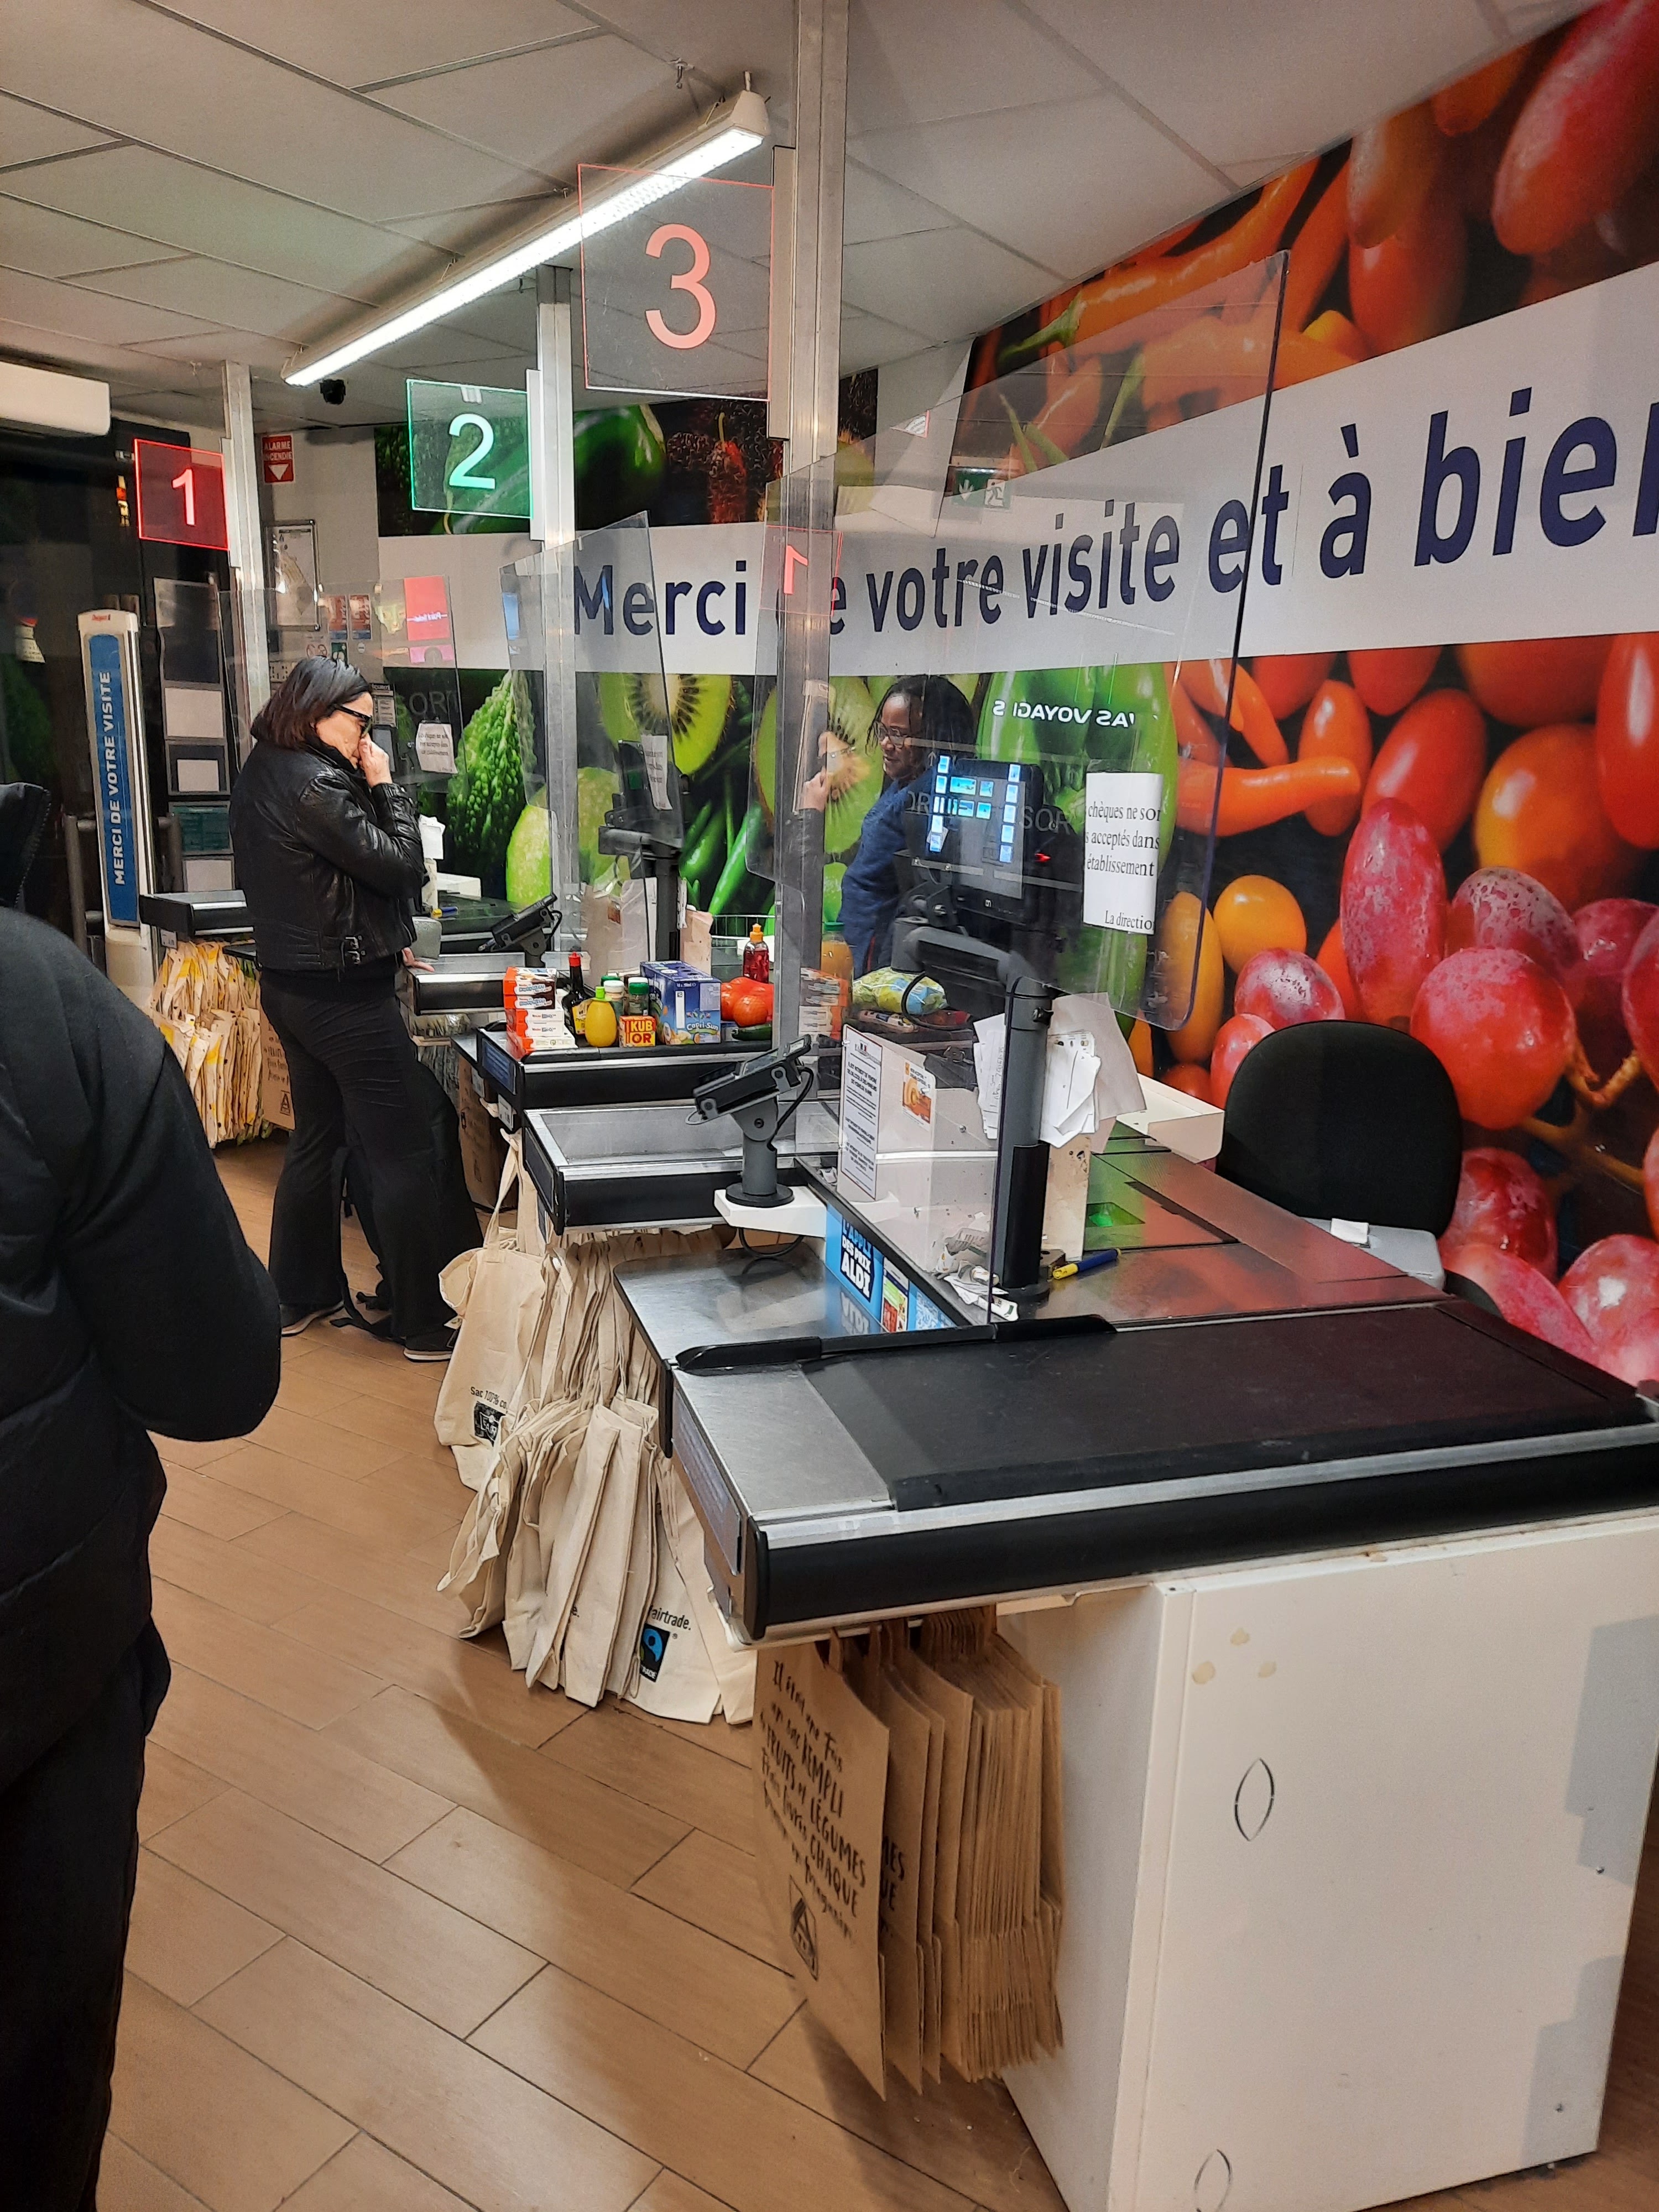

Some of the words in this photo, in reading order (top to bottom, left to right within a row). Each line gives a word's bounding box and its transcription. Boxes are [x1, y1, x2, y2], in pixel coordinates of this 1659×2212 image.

[645, 223, 717, 349] 3
[264, 440, 291, 451] ALARME
[448, 413, 495, 489] 2
[171, 468, 196, 526] 1
[575, 560, 748, 635] Merci
[866, 547, 1005, 634] votre
[1022, 499, 1180, 619] visite
[1208, 464, 1290, 594] et
[1319, 423, 1372, 579] à
[99, 671, 115, 733] VISITE
[103, 734, 120, 797] VOTRE
[110, 799, 122, 825] DE
[1088, 801, 1124, 823] chèques
[1126, 807, 1137, 820] ne
[112, 828, 126, 885] MERCI
[1091, 830, 1130, 851] acceptés
[1132, 830, 1160, 850] dans
[1087, 853, 1155, 877] établissement
[1104, 910, 1114, 925] La
[1116, 912, 1155, 931] directio
[631, 1020, 653, 1032] KUB
[632, 1032, 651, 1044] OR
[841, 1251, 872, 1298] ALDI
[842, 1234, 854, 1256] DES
[854, 1246, 872, 1274] PRIX
[470, 1386, 483, 1398] Sac
[767, 1723, 795, 1791] FRUITS
[810, 1797, 866, 1888] LÉGUMES
[810, 1833, 858, 1918] CHAQUE
